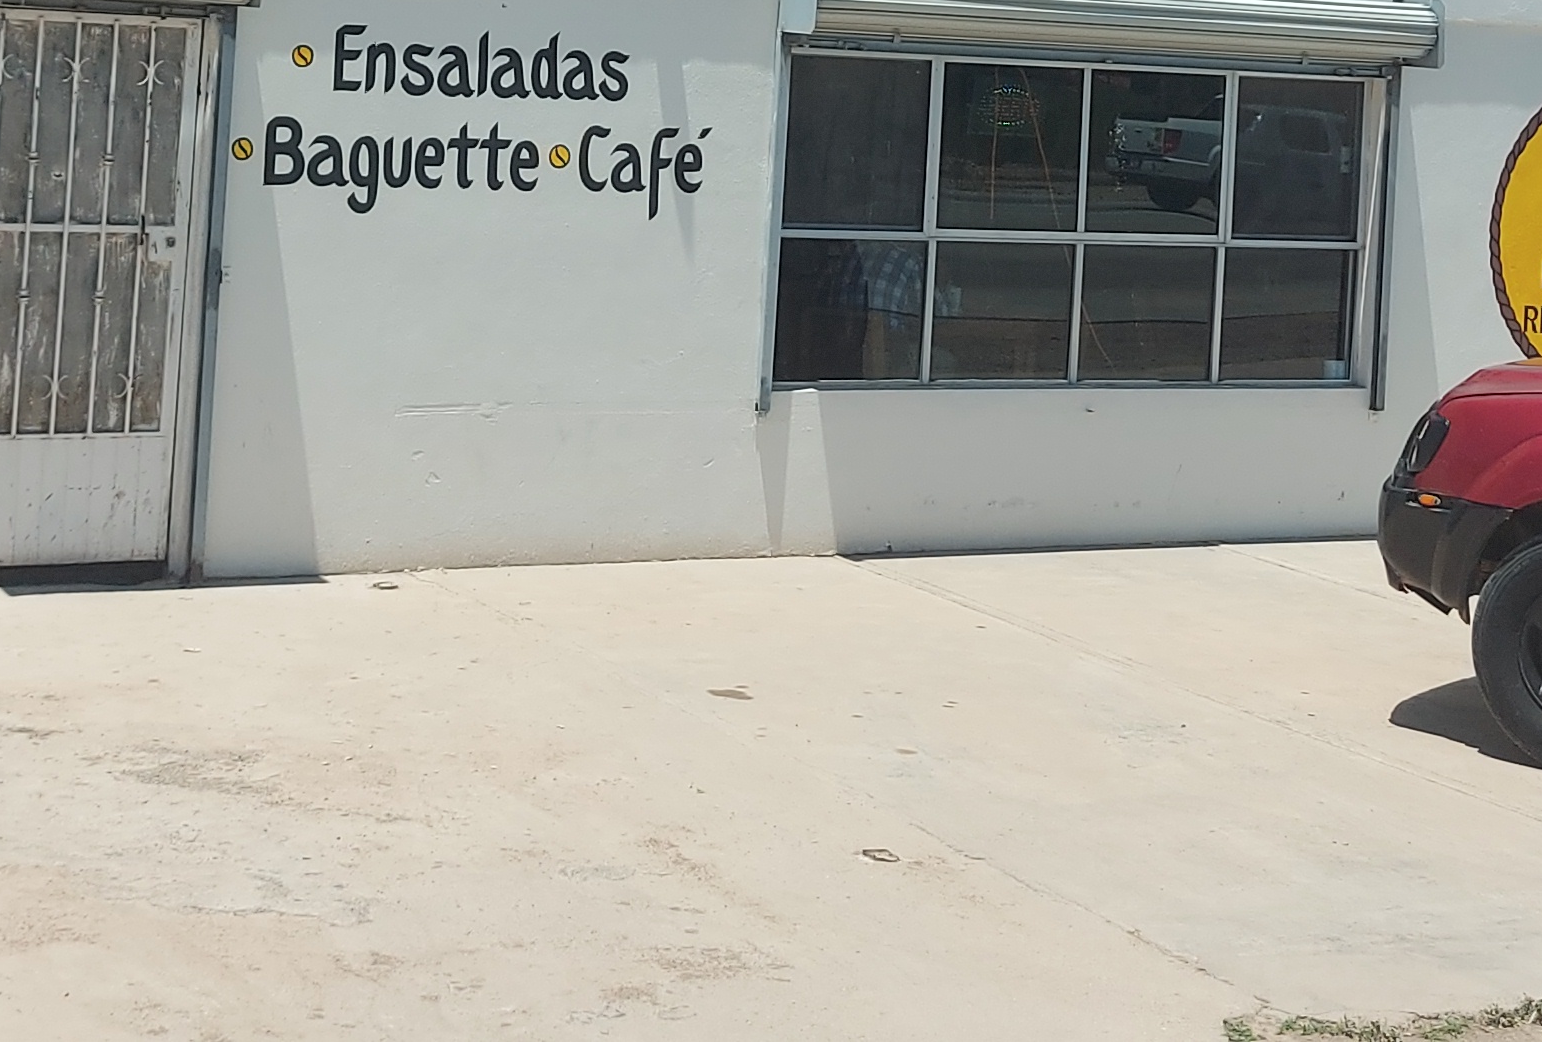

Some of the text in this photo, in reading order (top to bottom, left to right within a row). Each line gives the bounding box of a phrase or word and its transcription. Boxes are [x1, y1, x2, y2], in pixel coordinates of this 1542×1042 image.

[332, 24, 631, 102] Ensaladas
[262, 115, 714, 221] Baguette Café
